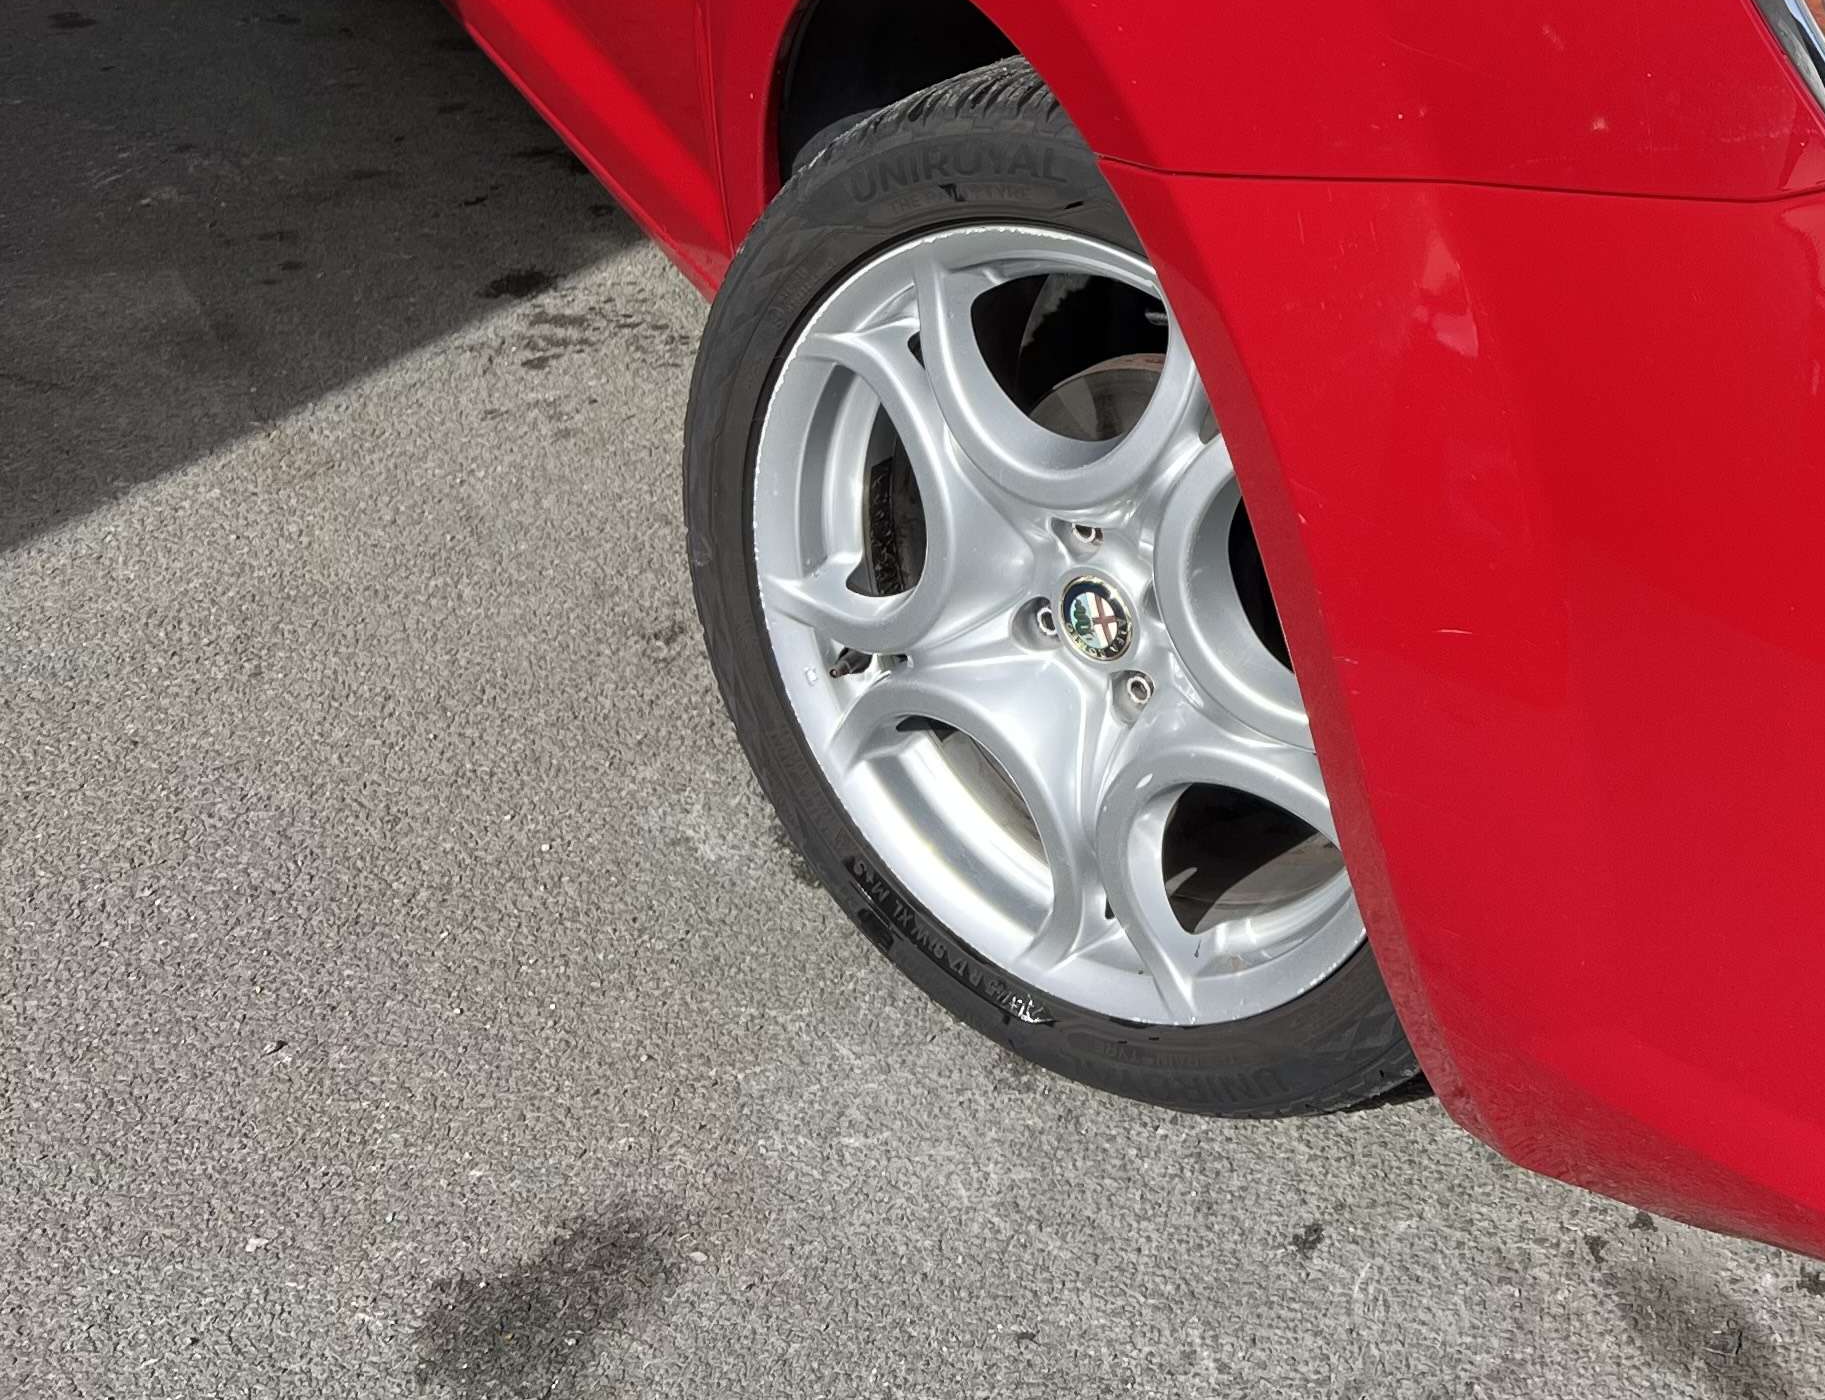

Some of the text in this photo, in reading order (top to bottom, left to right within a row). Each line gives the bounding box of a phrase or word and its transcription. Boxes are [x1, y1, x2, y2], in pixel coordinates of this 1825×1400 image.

[851, 139, 1068, 203] UNIROYAL
[853, 859, 890, 902] M+S
[894, 899, 914, 927] XL
